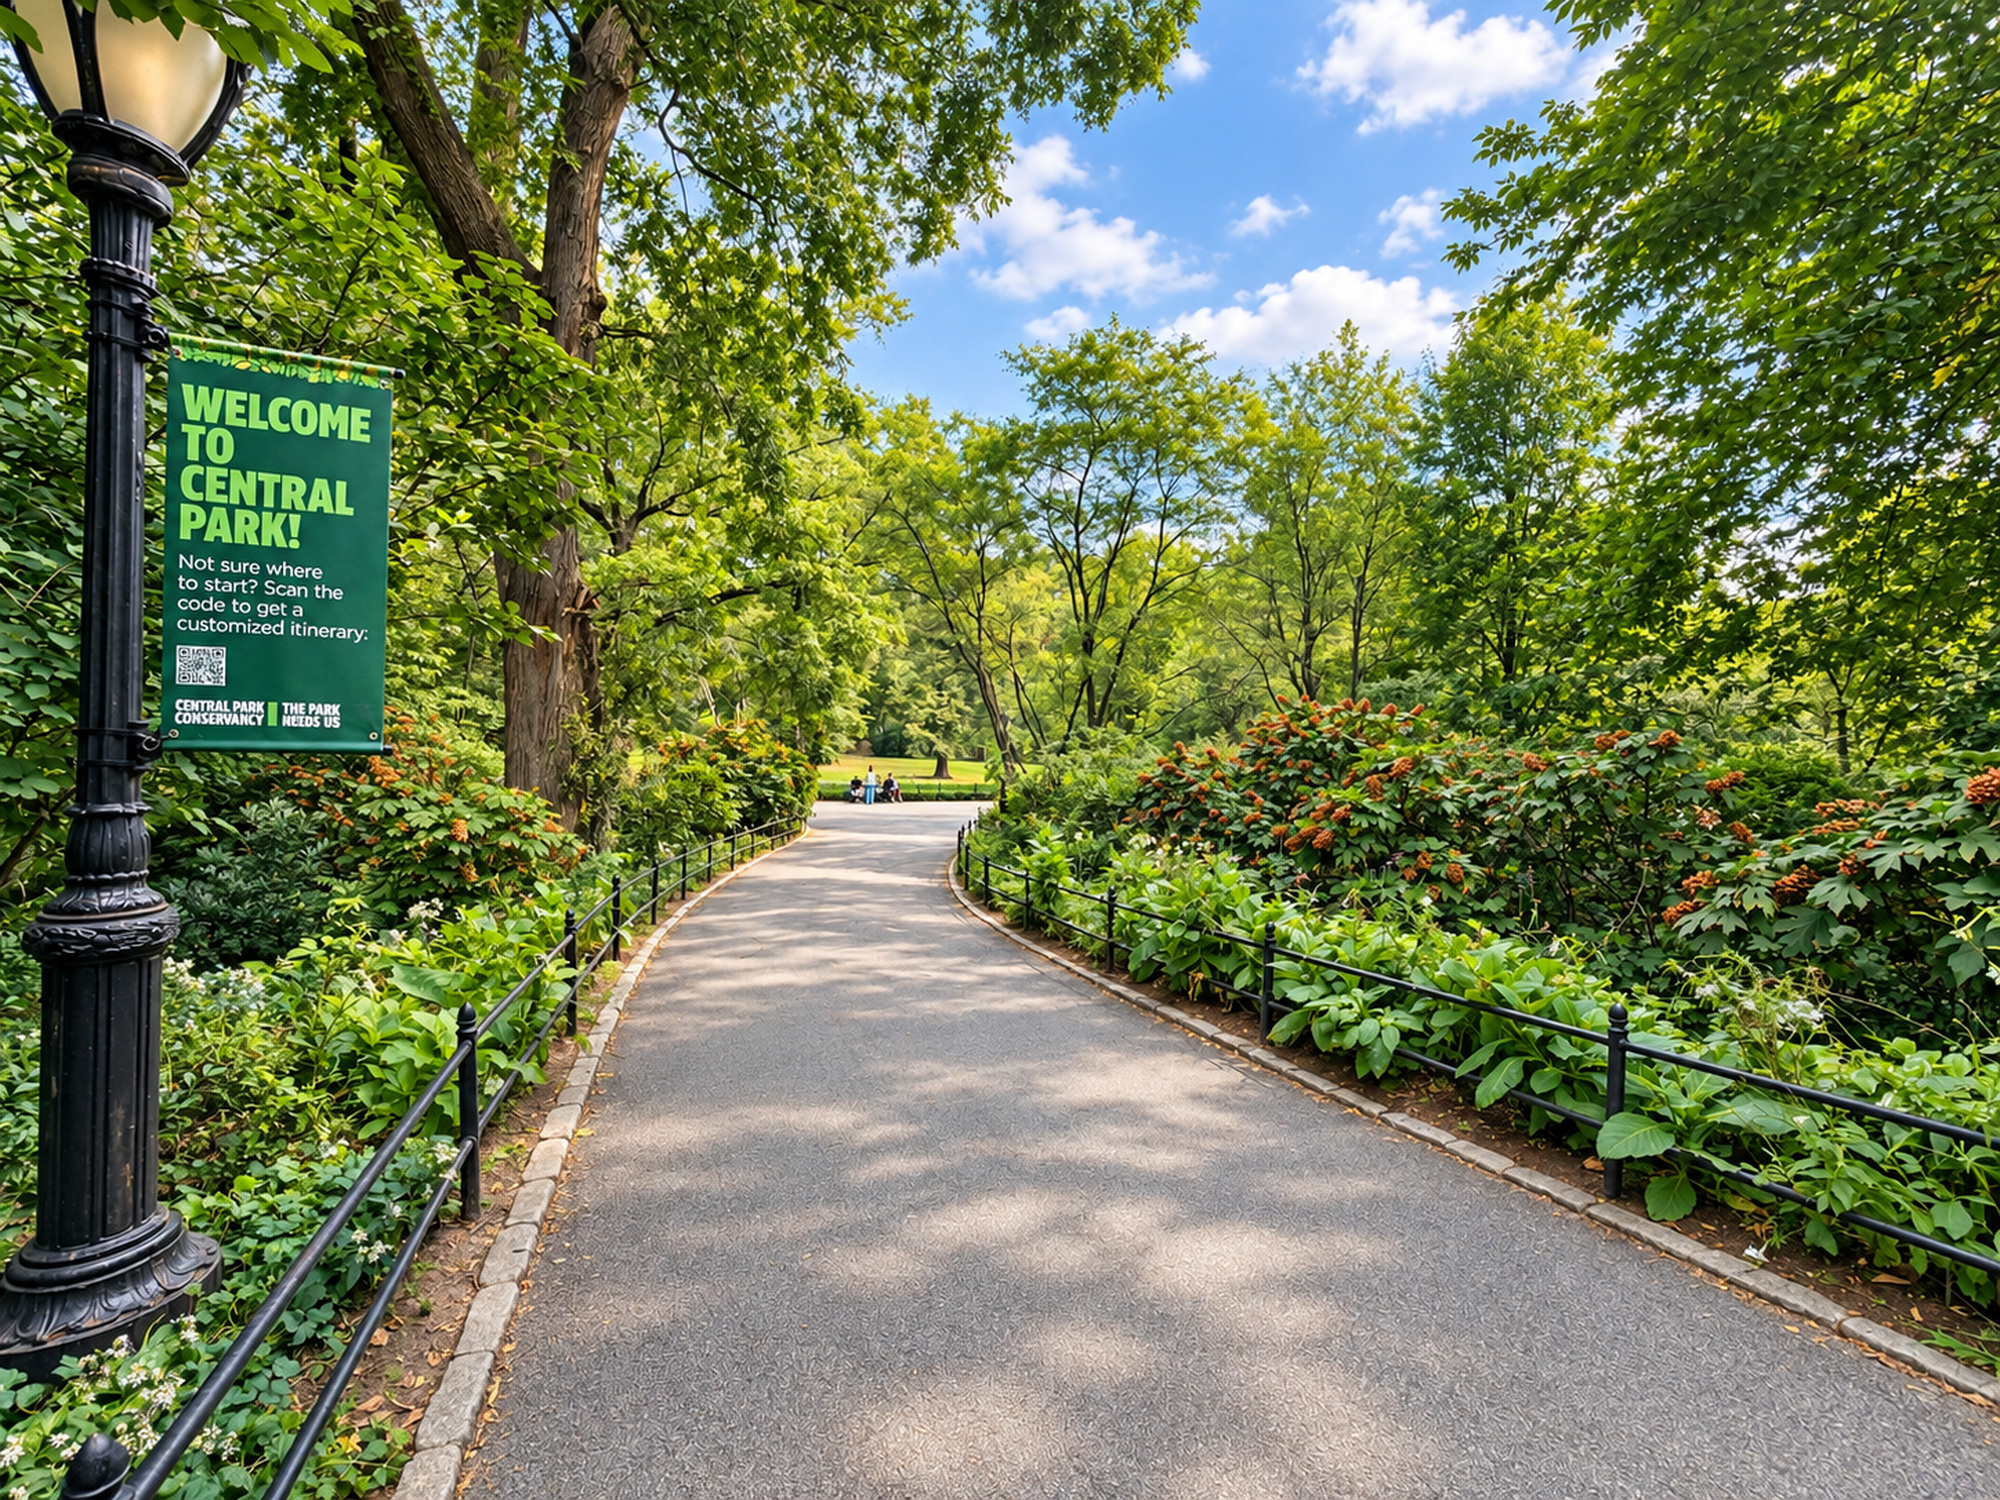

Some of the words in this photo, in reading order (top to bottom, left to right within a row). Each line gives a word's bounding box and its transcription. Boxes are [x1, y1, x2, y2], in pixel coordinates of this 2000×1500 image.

[181, 383, 371, 443] WELCOME
[181, 423, 235, 465] TO
[180, 464, 354, 516] CENTRAL
[179, 503, 301, 549] PARK!
[178, 554, 215, 571] Not
[221, 560, 261, 575] sure
[266, 561, 323, 580] where
[178, 575, 199, 591] to
[204, 577, 259, 595] start?
[264, 580, 308, 598] Scan
[314, 584, 344, 600] the
[177, 596, 225, 613] code
[232, 599, 251, 614] to
[257, 602, 287, 618] get
[292, 605, 303, 617] a
[177, 618, 284, 636] customized
[290, 620, 369, 643] itinerary:
[174, 712, 265, 726] CONSERVANCY
[175, 699, 230, 713] CENTRAL
[232, 700, 265, 714] PARK
[282, 702, 307, 715] THE
[309, 703, 341, 716] PARK
[282, 714, 321, 728] NEEDS
[323, 716, 341, 728] US
